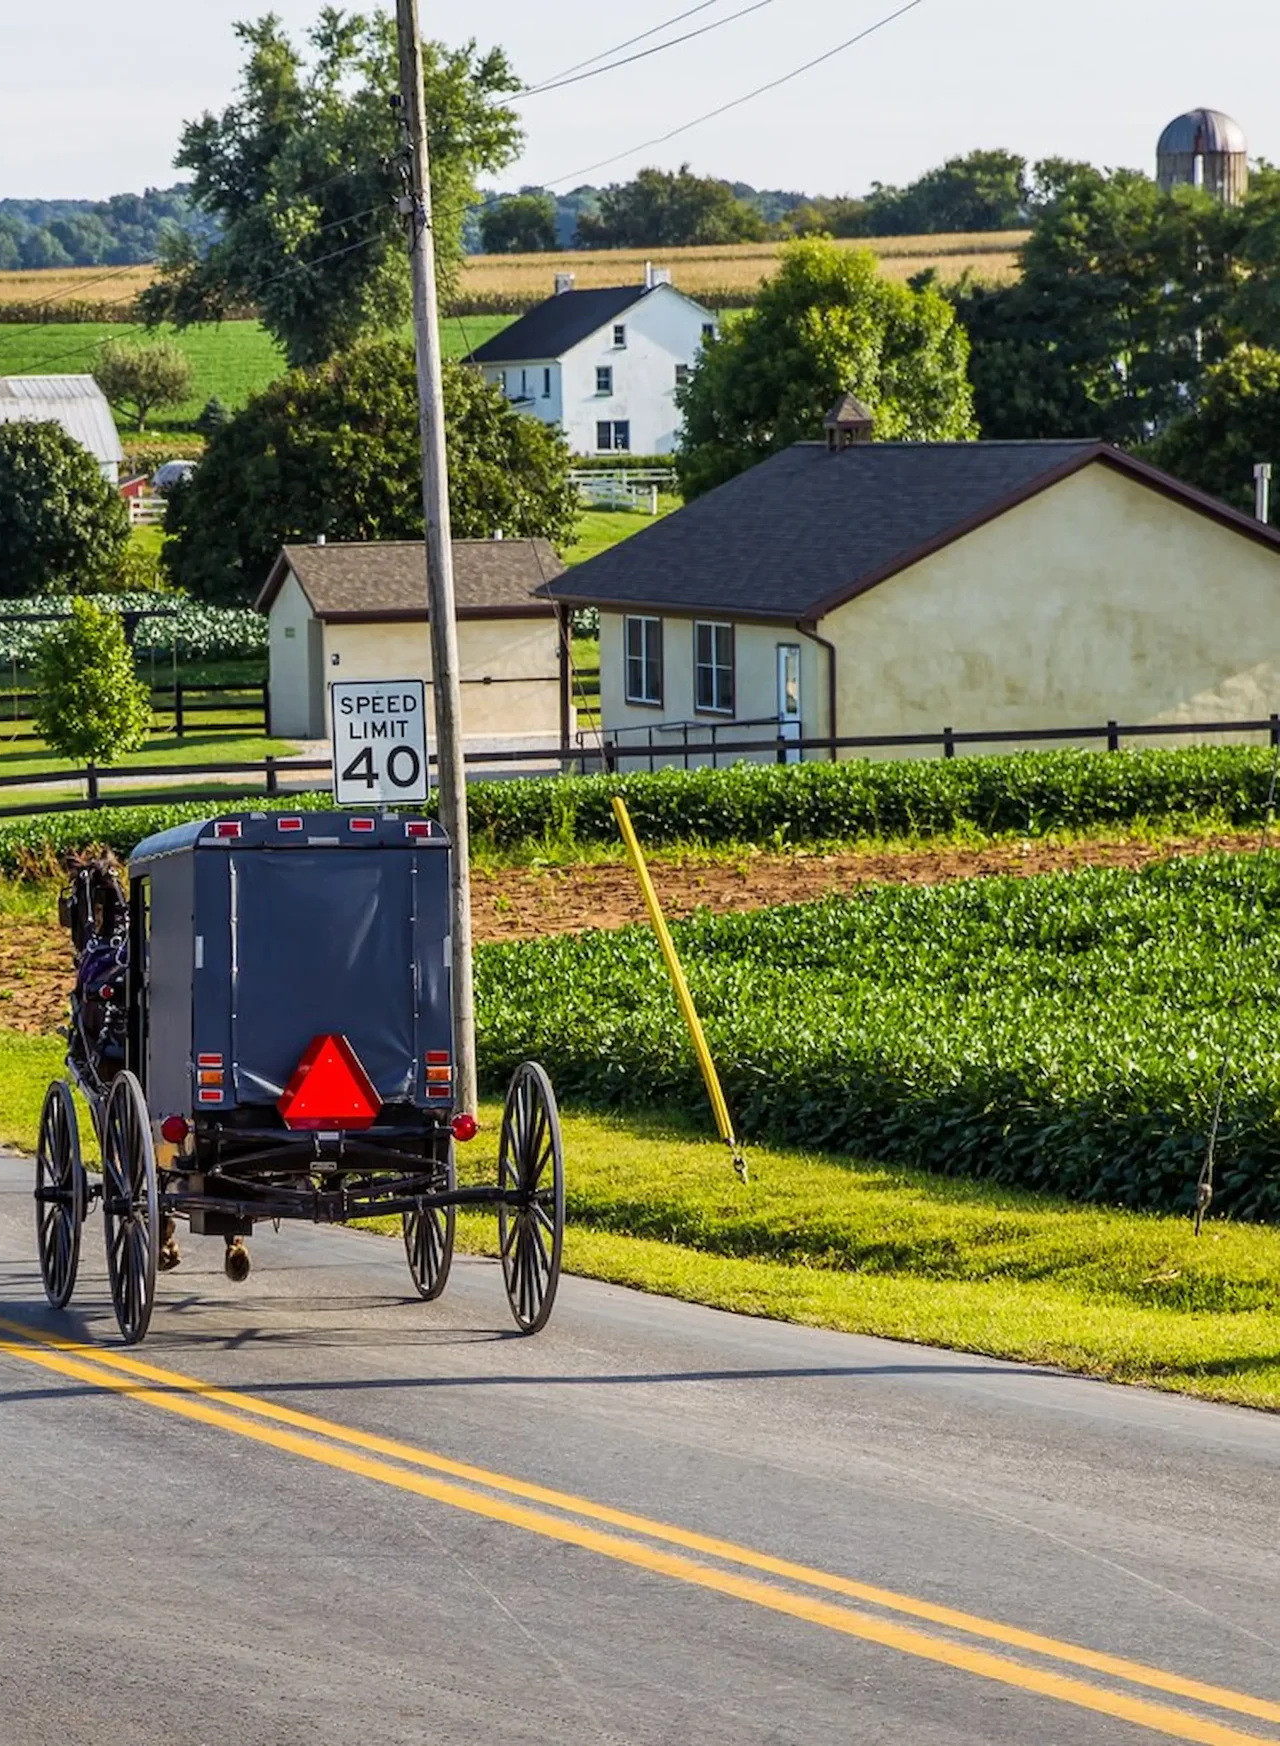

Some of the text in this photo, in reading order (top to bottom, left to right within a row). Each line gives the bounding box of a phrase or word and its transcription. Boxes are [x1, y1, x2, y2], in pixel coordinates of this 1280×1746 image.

[340, 694, 417, 715] SPEED
[349, 720, 408, 739] LIMIT
[342, 745, 420, 789] 40
